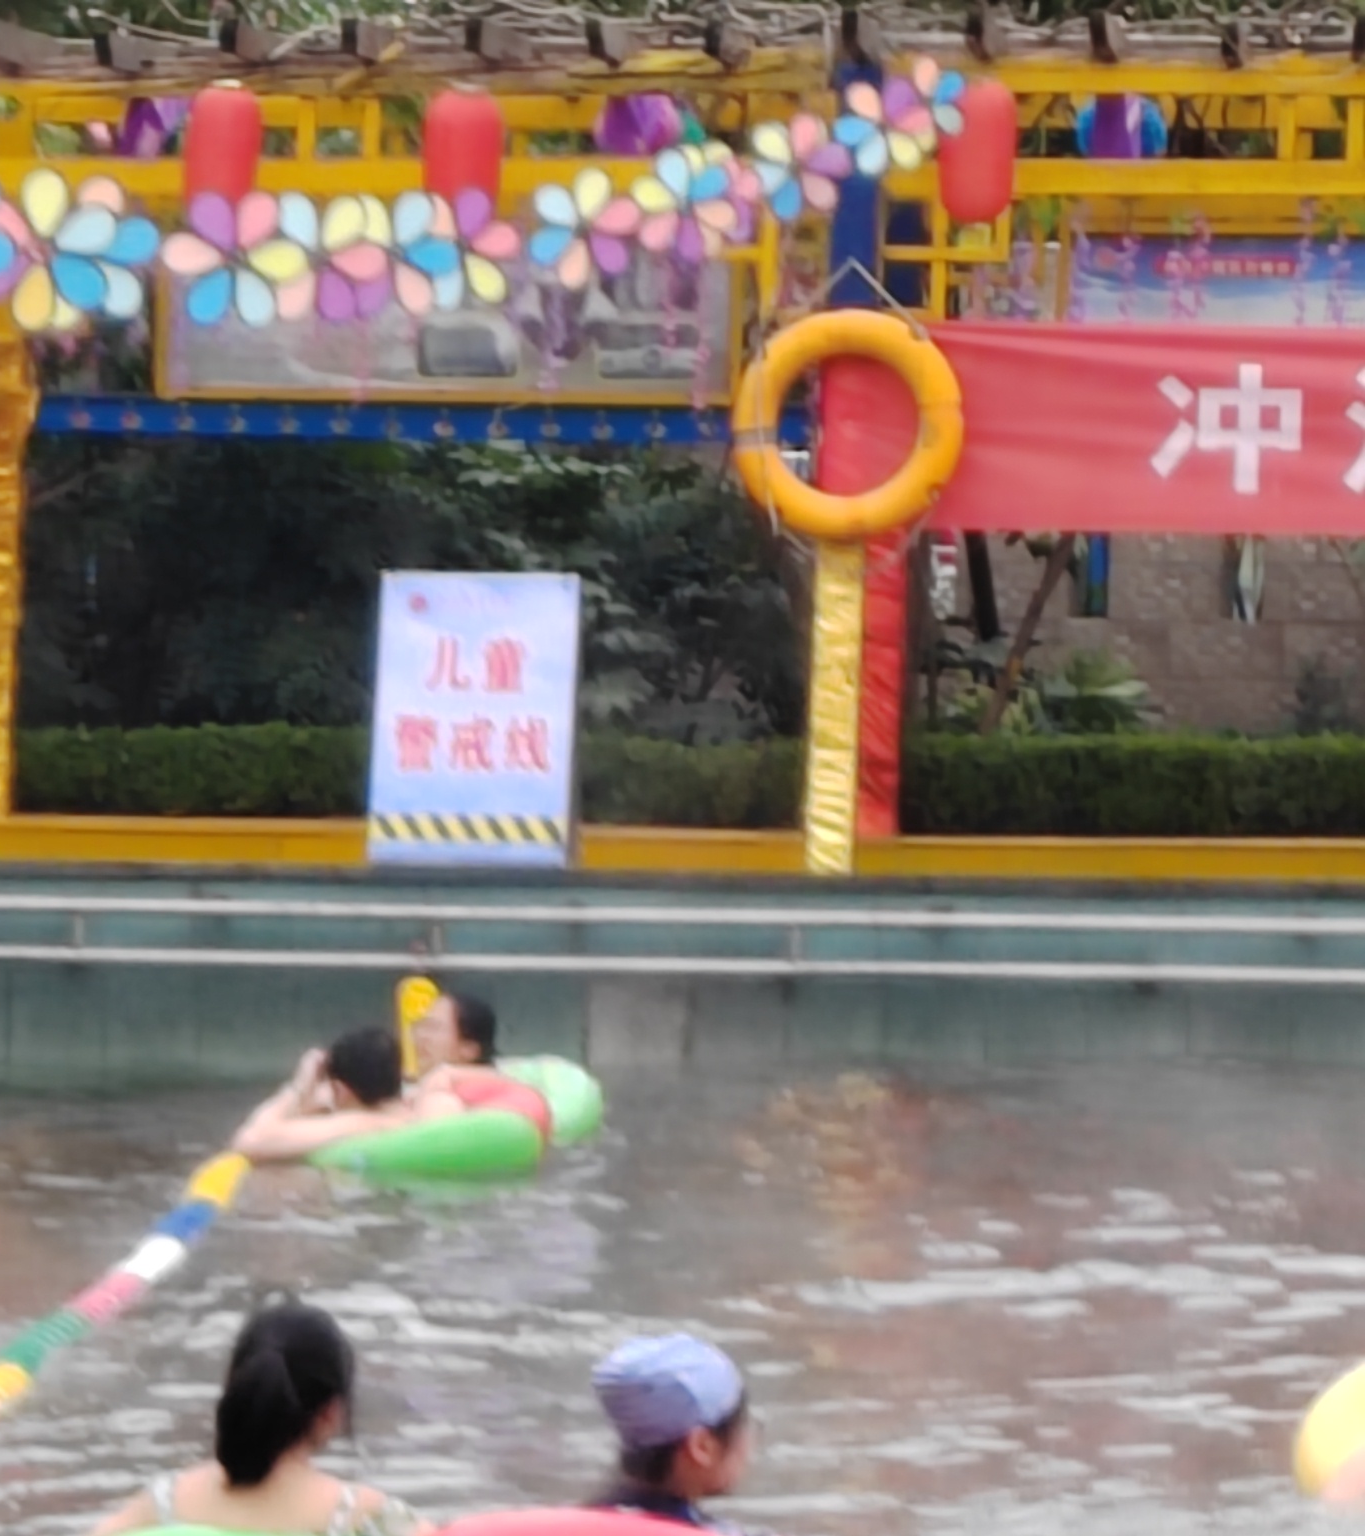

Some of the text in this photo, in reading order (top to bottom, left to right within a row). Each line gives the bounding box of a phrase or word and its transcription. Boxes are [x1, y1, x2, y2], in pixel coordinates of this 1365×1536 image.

[1149, 362, 1365, 496] 冲
[425, 635, 527, 694] 儿童
[394, 713, 552, 773] 警戒线
